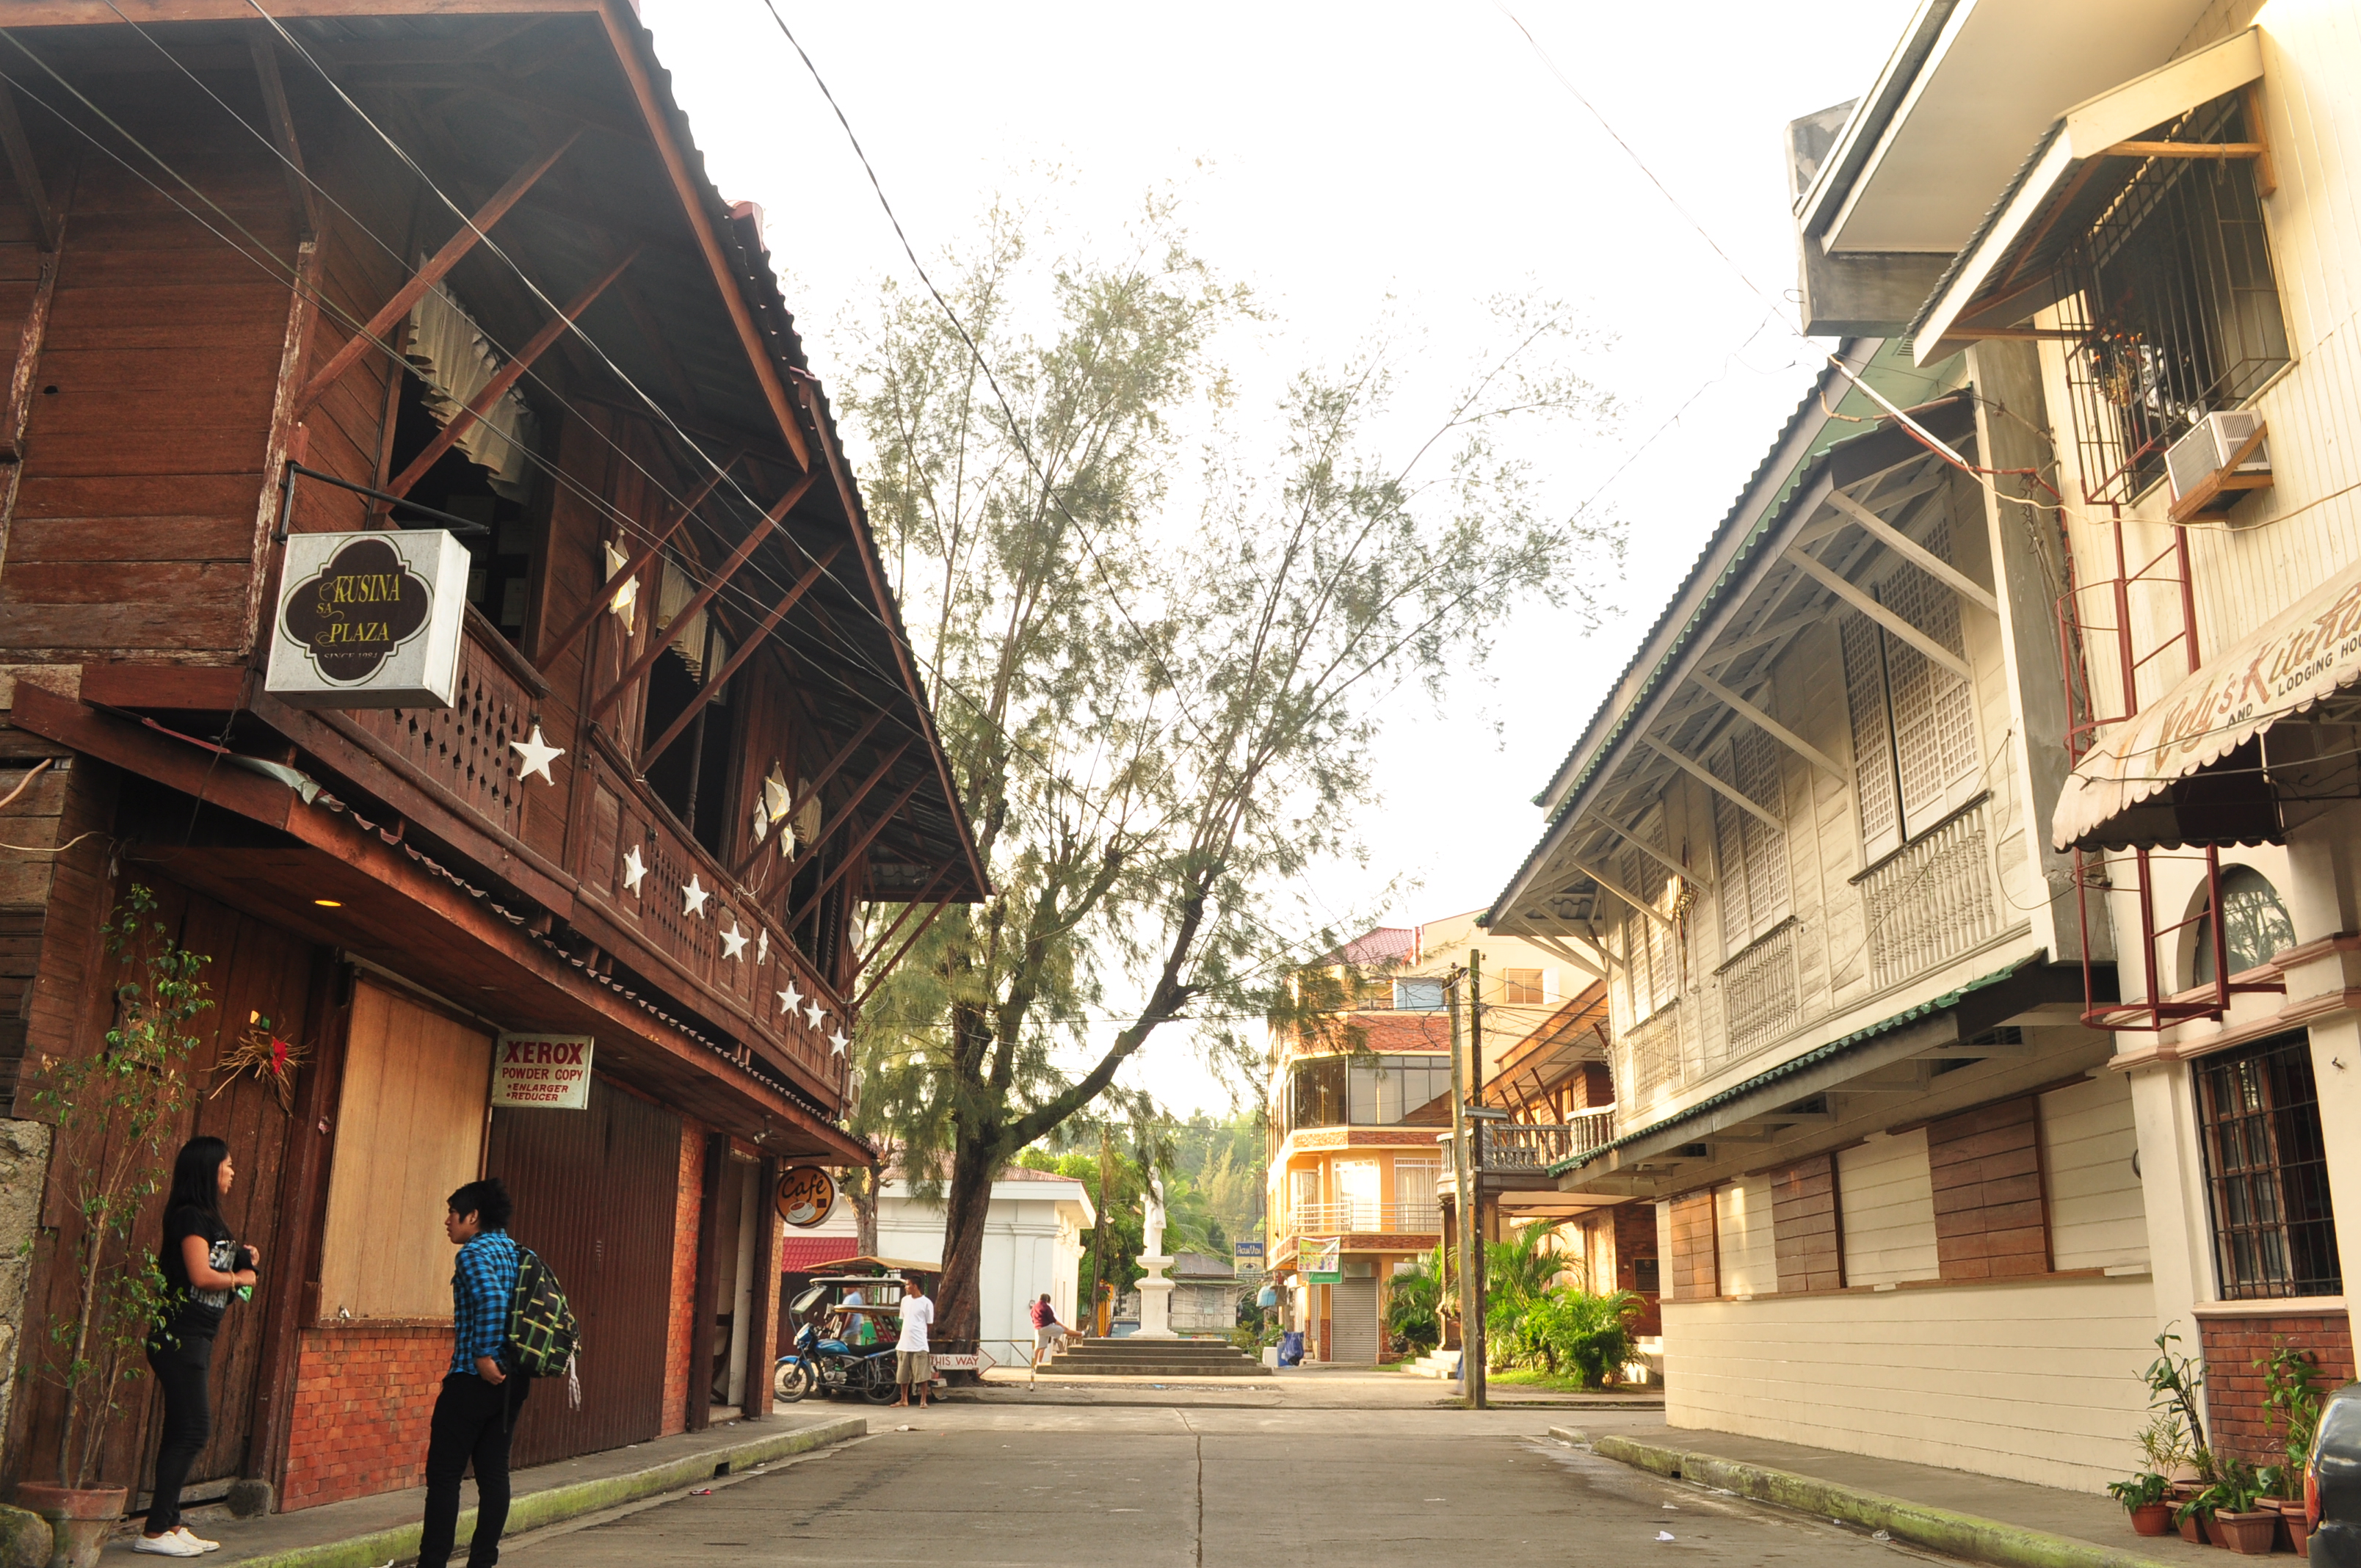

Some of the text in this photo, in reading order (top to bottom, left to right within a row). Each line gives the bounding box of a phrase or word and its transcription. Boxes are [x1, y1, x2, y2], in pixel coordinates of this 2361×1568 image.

[319, 574, 400, 603] KUSINA
[316, 602, 333, 614] SA
[320, 622, 390, 645] PLAZA
[2227, 703, 2253, 729] AND
[2278, 652, 2333, 697] LODGING
[503, 1041, 584, 1065] XEROX
[502, 1067, 584, 1081] POWDER COPY
[511, 1092, 559, 1101] REDUCER
[512, 1083, 569, 1093] ENLARGER
[782, 1172, 827, 1203] Café
[930, 1355, 979, 1366] THIS WAY
